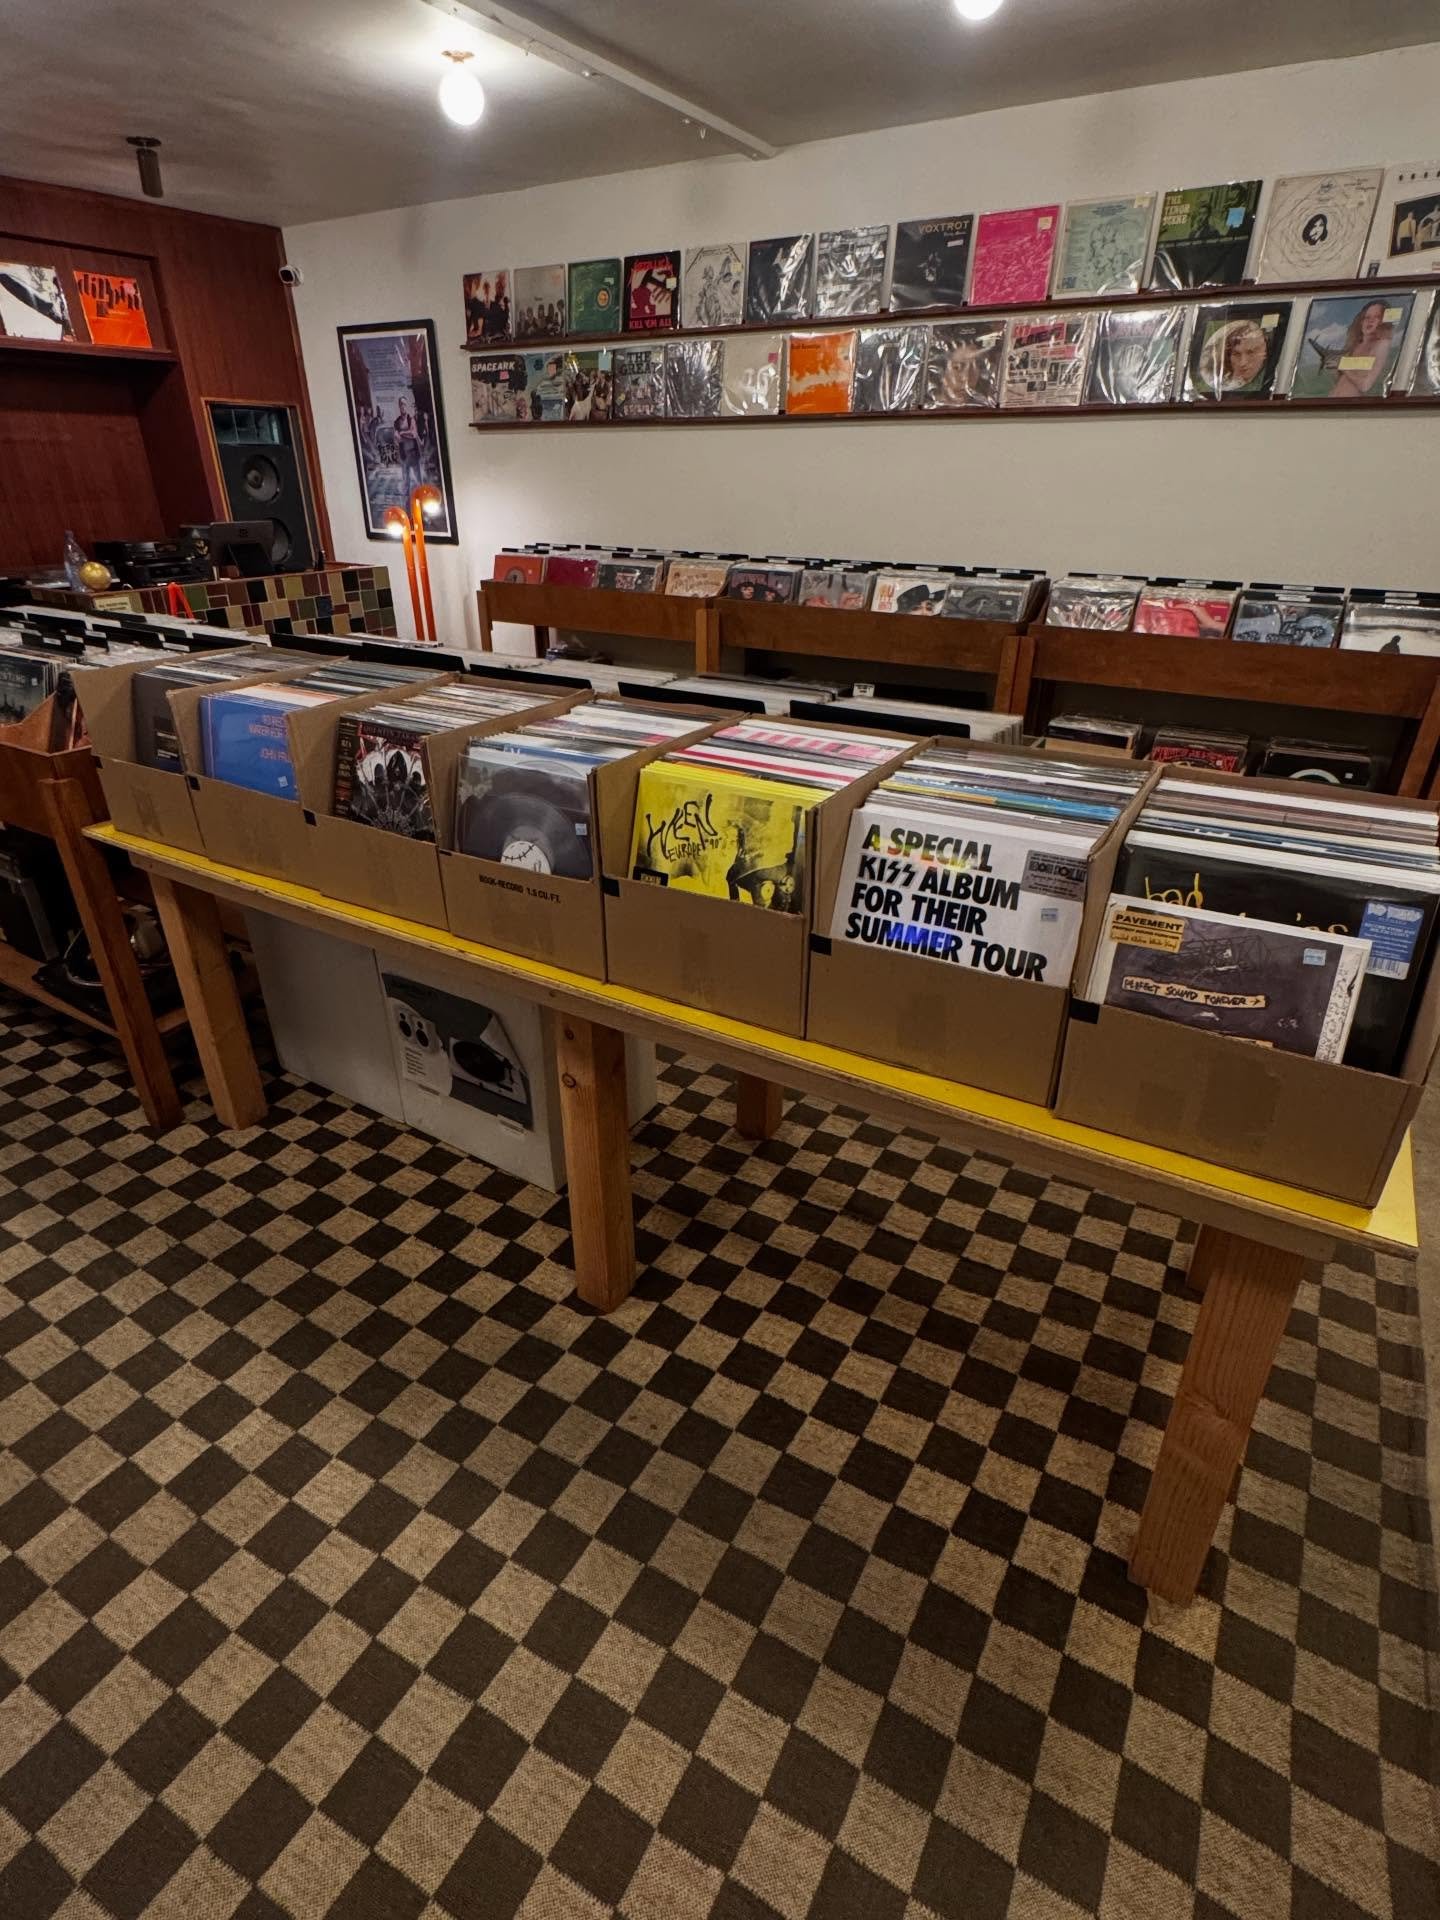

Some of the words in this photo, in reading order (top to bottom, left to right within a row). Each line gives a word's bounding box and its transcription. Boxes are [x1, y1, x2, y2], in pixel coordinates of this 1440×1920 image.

[918, 220, 970, 233] VOXTROT
[472, 361, 516, 373] SPACEARK
[668, 841, 702, 863] EUROPE
[862, 823, 881, 852] A
[887, 828, 992, 873] SPECIAL
[858, 854, 917, 888] KISS
[919, 866, 1021, 911] ALBUM
[850, 883, 903, 918] FOR
[911, 895, 988, 936] THEIR
[1115, 914, 1183, 931] PAVEMENT
[845, 913, 963, 963] SUMMER
[970, 940, 1048, 983] TOUR
[1124, 978, 1161, 995] PERFECT
[1165, 986, 1198, 999] SOUND
[1203, 994, 1248, 1006] FOREVER
